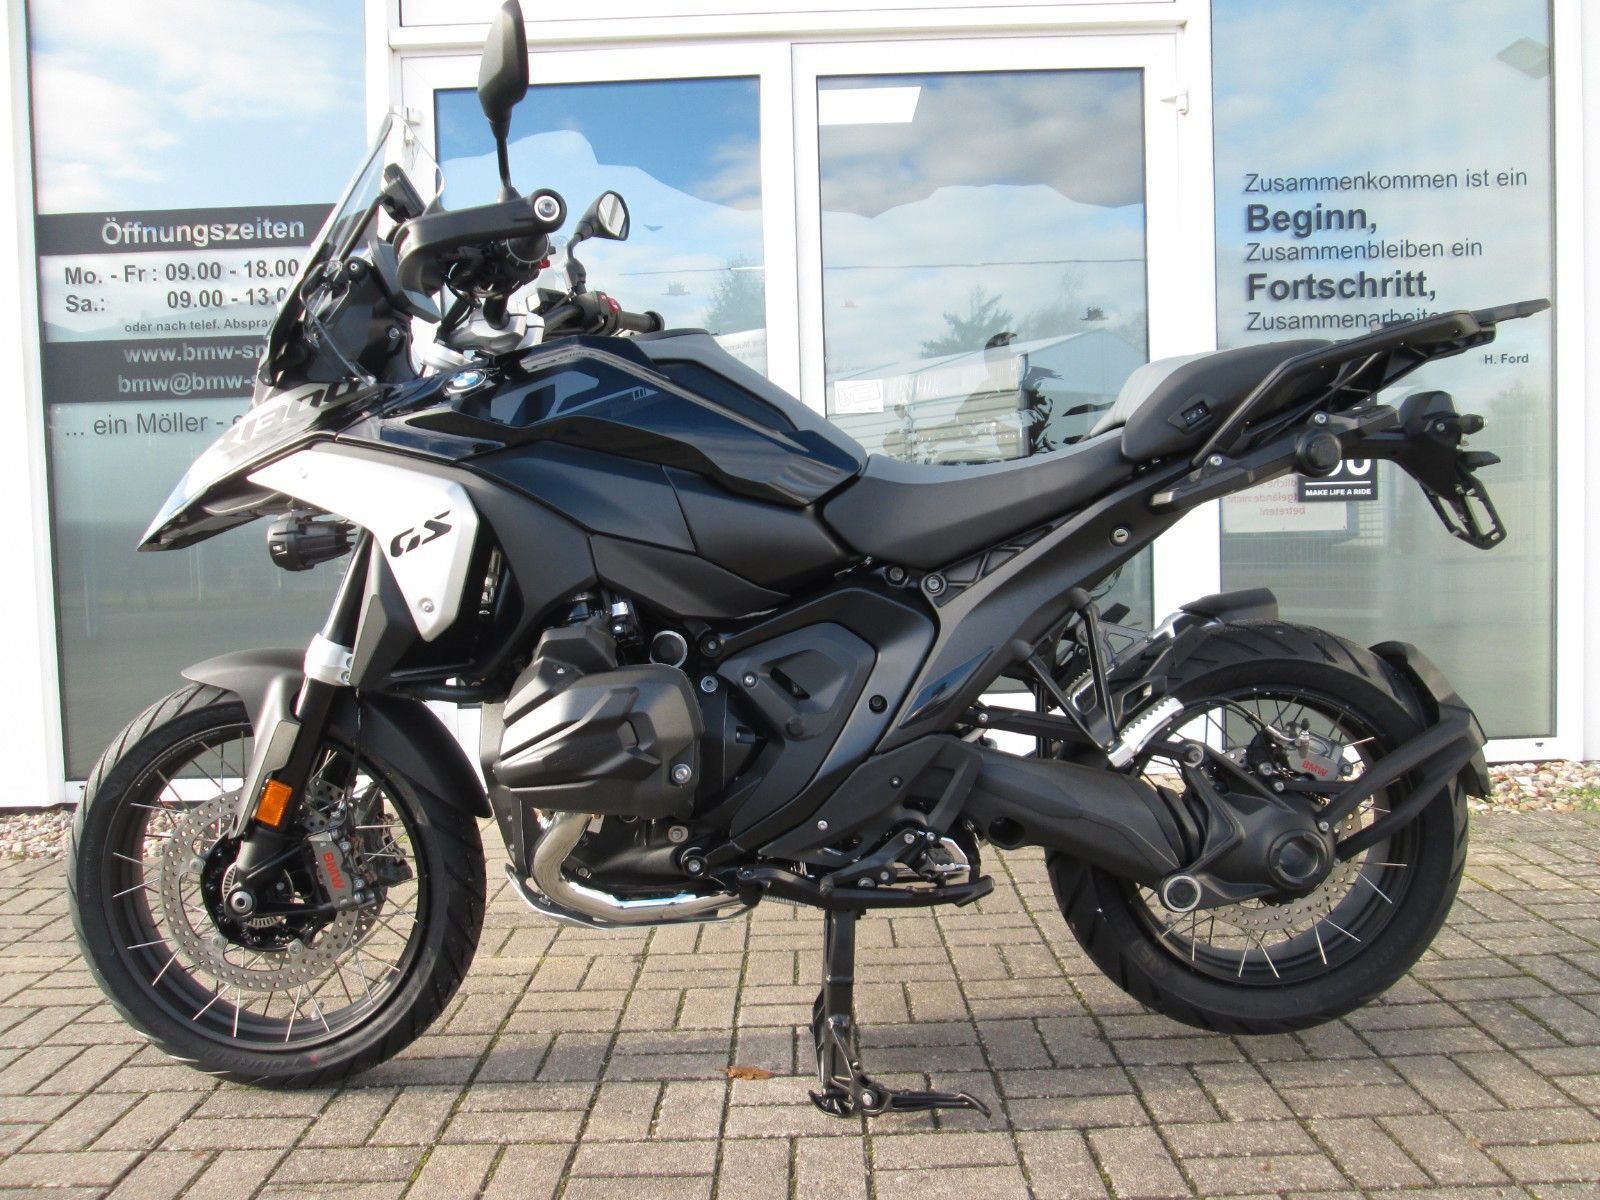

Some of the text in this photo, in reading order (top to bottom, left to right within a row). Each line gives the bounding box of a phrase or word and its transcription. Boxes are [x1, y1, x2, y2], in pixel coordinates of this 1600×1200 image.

[1245, 168, 1527, 192] Zusammenkommen ist ein
[101, 216, 305, 247] Öffnungszeiten
[1247, 203, 1377, 238] Beginn,
[1246, 238, 1483, 262] Zusammenbleiben ein
[65, 267, 102, 285] Mo.
[165, 262, 221, 281] 09.00
[244, 259, 299, 278] 18.00
[1248, 270, 1436, 300] Fortschritt,
[65, 294, 105, 313] Sa.:
[167, 290, 223, 309] 09.00
[124, 322, 151, 332] oder
[156, 321, 186, 331] nach
[190, 319, 220, 330] telef.
[1484, 353, 1529, 365] H. Ford
[94, 414, 127, 435] ein
[137, 412, 208, 434] Möller
[389, 509, 453, 558] GS
[1302, 760, 1329, 777] BMW
[322, 851, 346, 890] BMW
